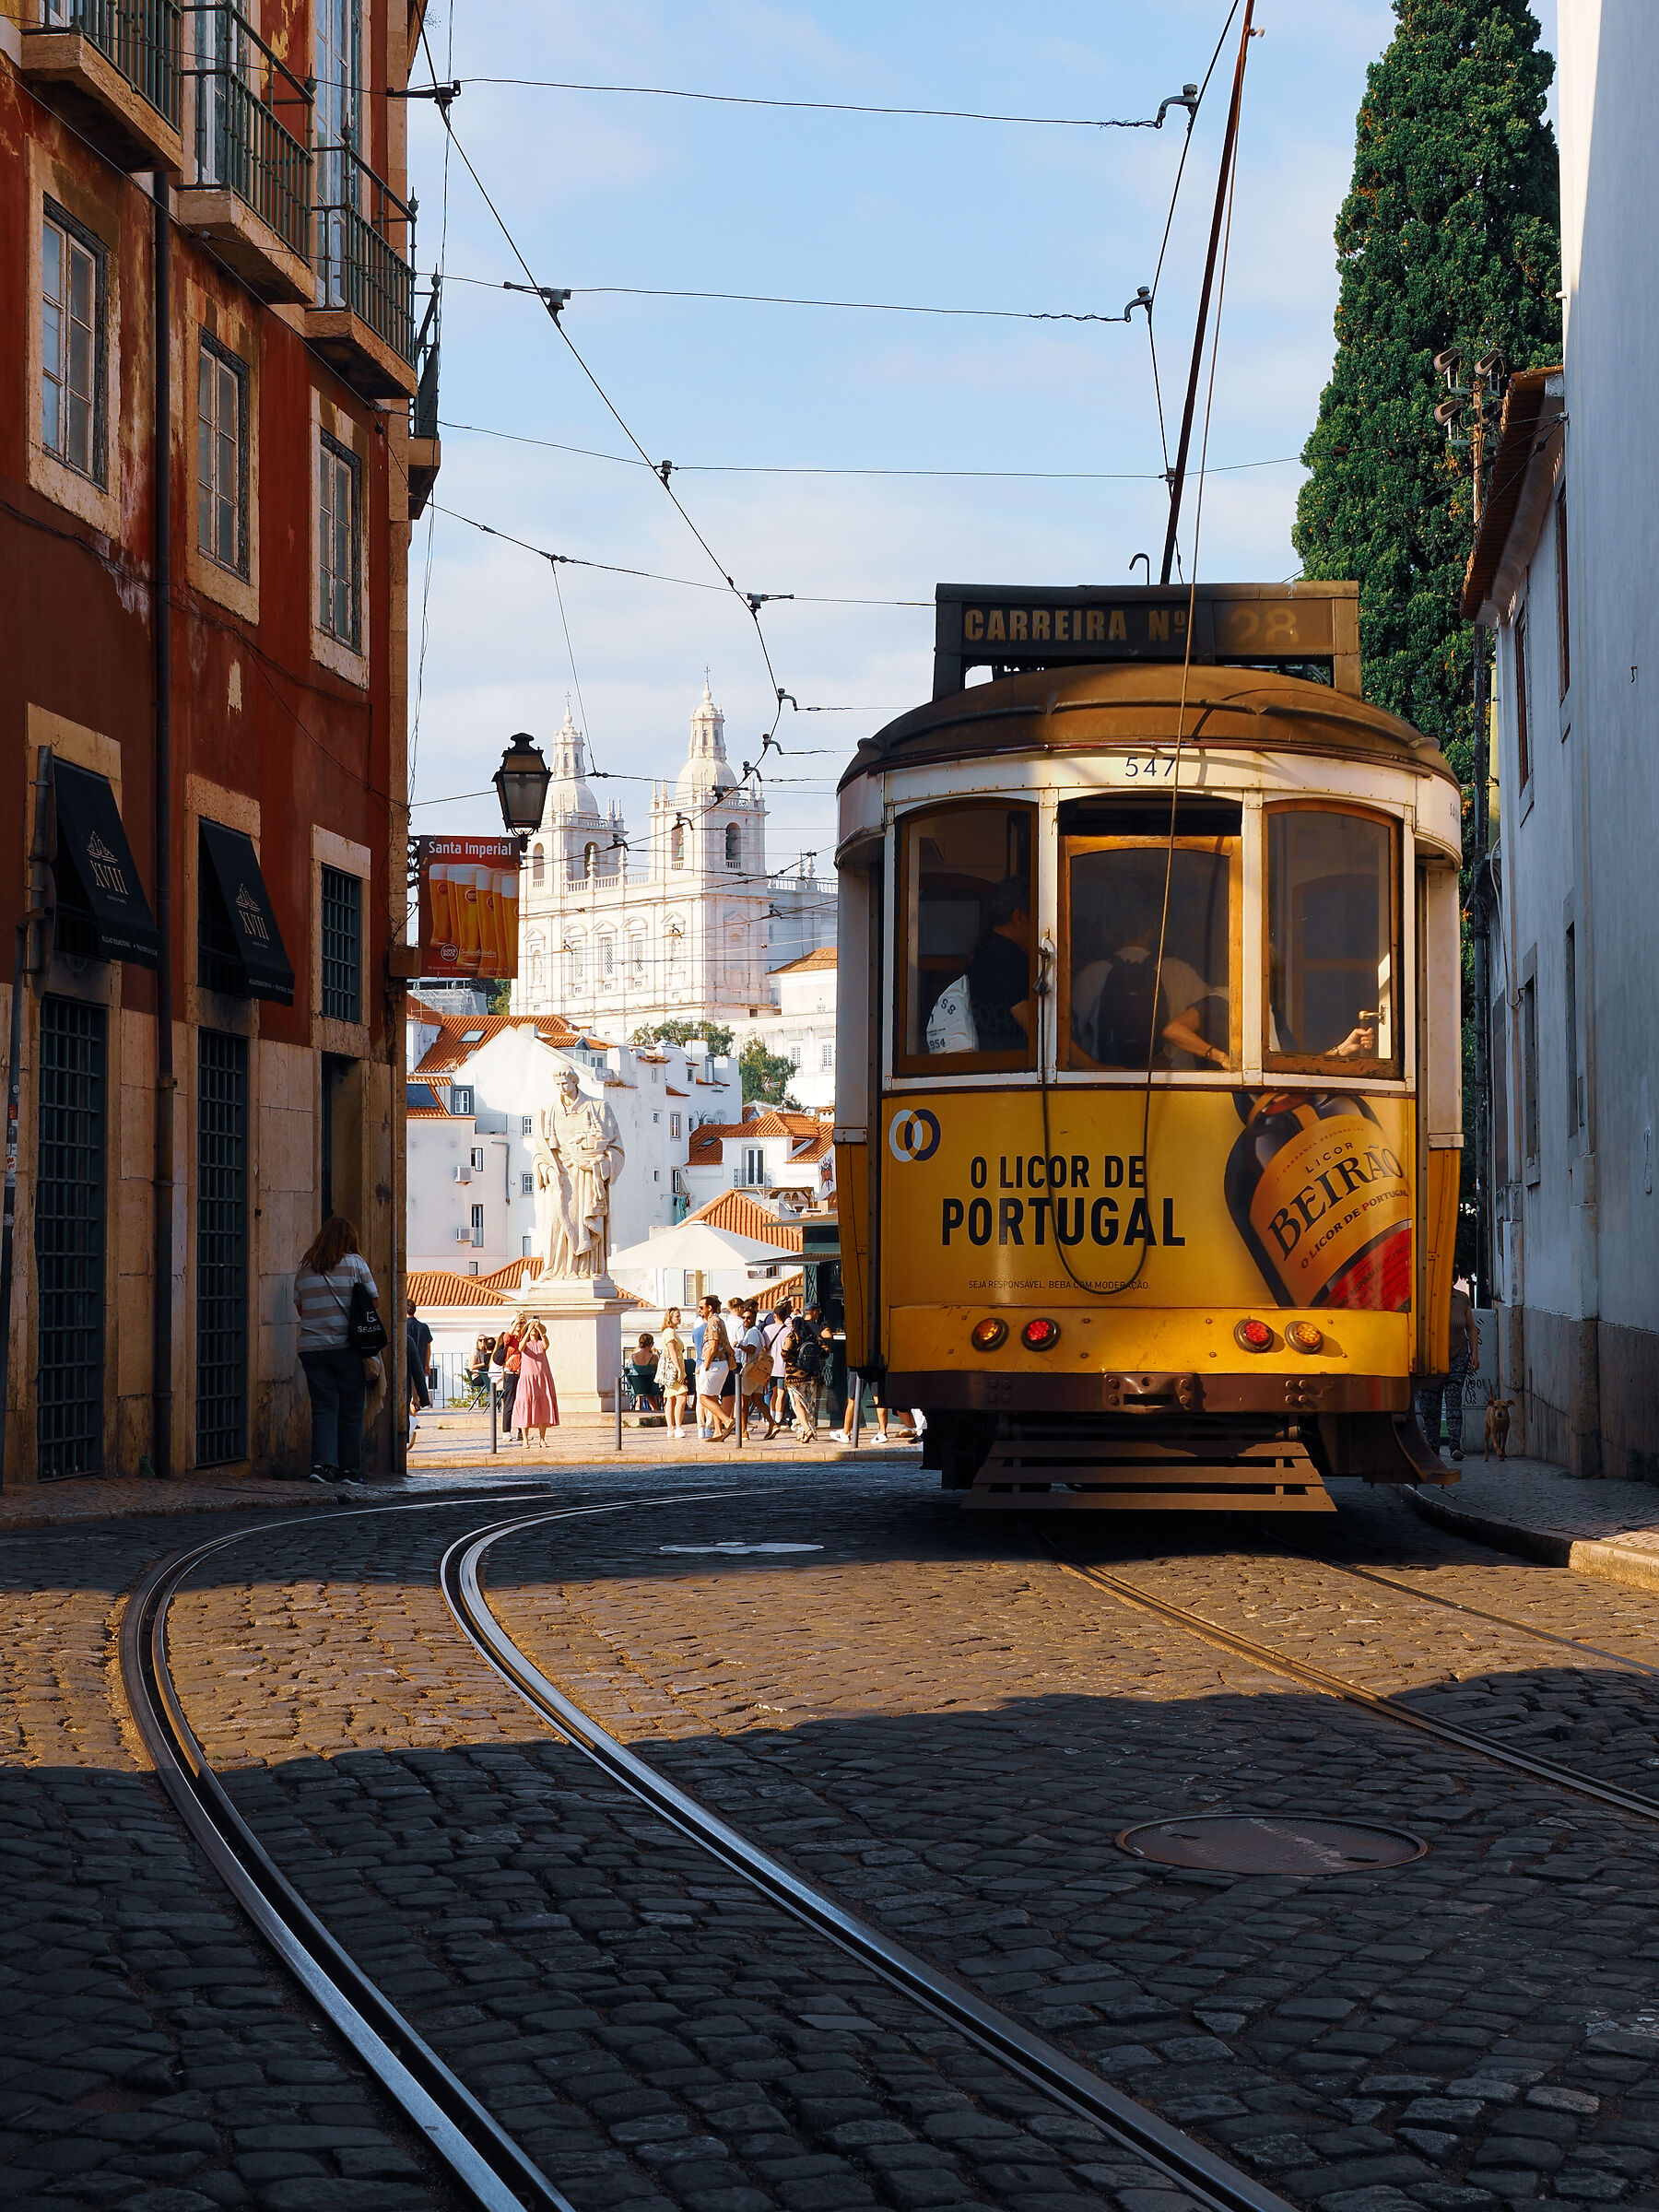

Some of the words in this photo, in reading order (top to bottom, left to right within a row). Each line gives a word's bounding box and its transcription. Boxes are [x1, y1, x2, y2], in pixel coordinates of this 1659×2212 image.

[964, 609, 1127, 641] CARREIRA
[1148, 609, 1186, 641] Nº
[1230, 607, 1300, 643] 28
[1124, 756, 1177, 777] 547
[429, 841, 462, 855] Santa
[465, 841, 512, 858] Imperial
[89, 859, 129, 895] XVIII
[238, 909, 270, 941] XVIII
[971, 1156, 988, 1189] O
[999, 1155, 1090, 1189] LICOR
[1104, 1155, 1146, 1189] DE
[1304, 1142, 1354, 1173] LICOR
[1267, 1144, 1404, 1262] BEIRÃO
[942, 1197, 1186, 1247] PORTUGAL
[1300, 1257, 1310, 1269] O
[1308, 1222, 1344, 1257] LICOR
[1343, 1207, 1361, 1225] DE
[1361, 1189, 1409, 1212] PORTUGAL
[968, 1279, 987, 1289] SEJA
[1048, 1280, 1071, 1289] BEBA
